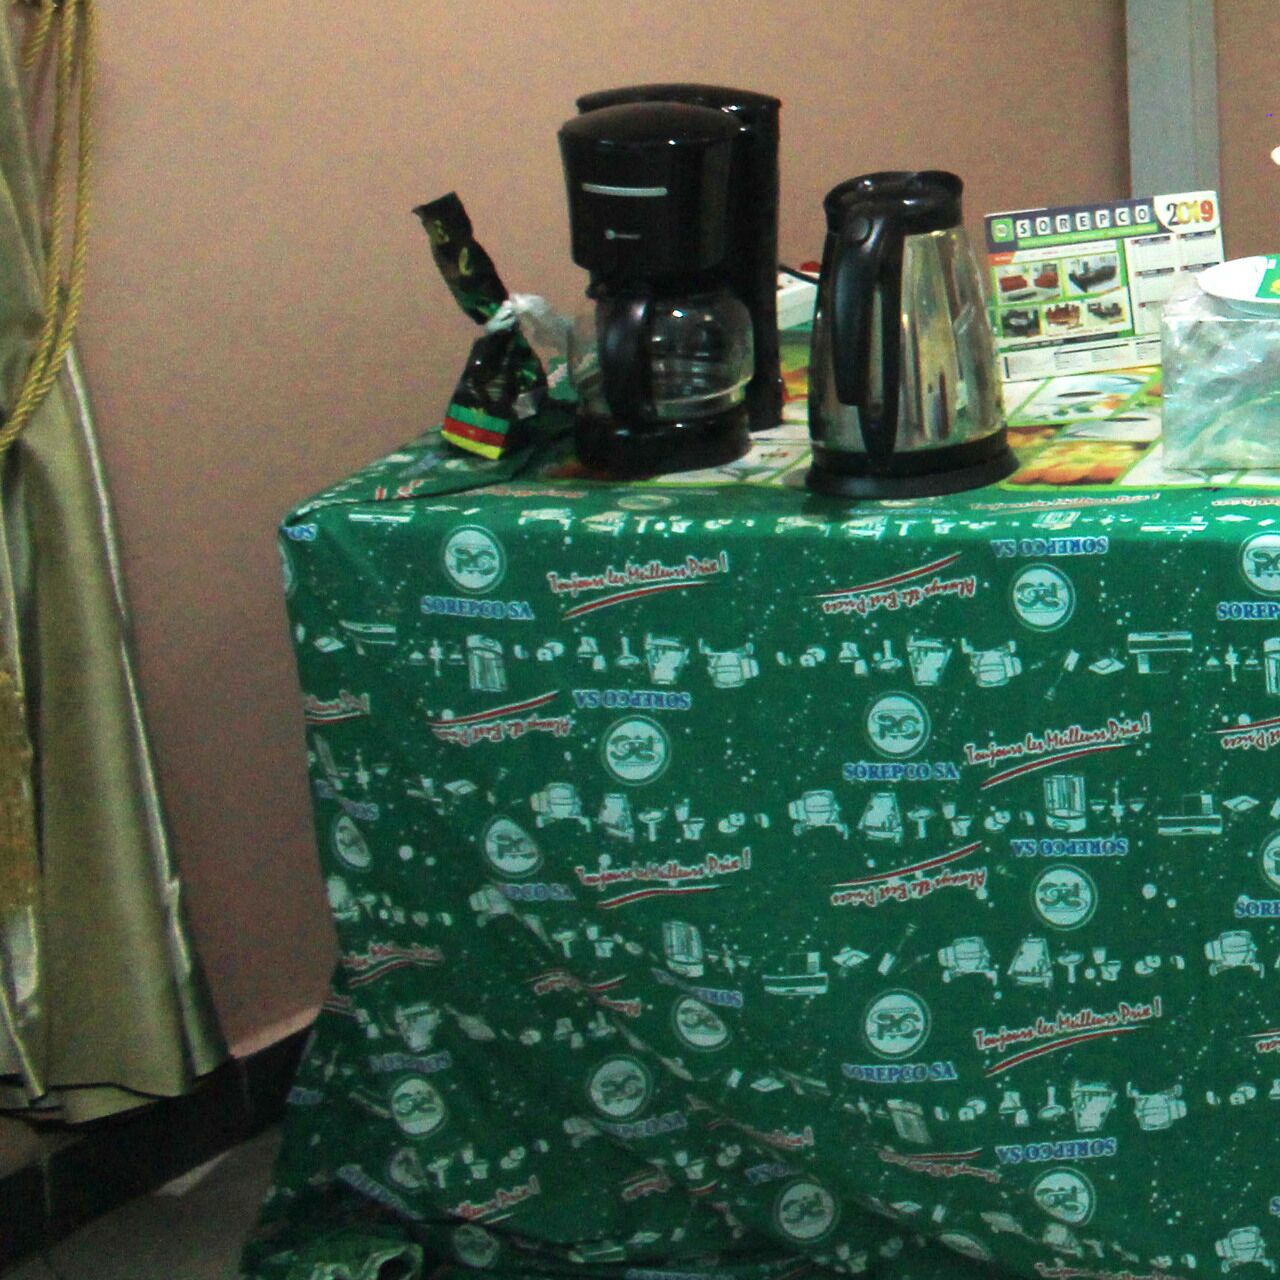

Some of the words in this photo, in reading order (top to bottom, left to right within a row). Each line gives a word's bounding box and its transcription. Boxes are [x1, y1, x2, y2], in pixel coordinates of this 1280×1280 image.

[1018, 206, 1149, 236] SOREPCO
[1166, 199, 1215, 226] 2019
[924, 577, 976, 596] Always
[869, 590, 900, 611] Best
[902, 587, 923, 607] the
[965, 743, 1023, 768] Toujours
[1024, 734, 1044, 754] les
[1044, 726, 1107, 749] Meilleurs
[1107, 718, 1142, 739] Prix
[843, 763, 930, 781] SOREPCO
[932, 763, 960, 781] SA
[1010, 840, 1038, 858] SA
[1039, 838, 1128, 857] SOREPCO
[1120, 1001, 1153, 1024] Prix
[996, 1145, 1022, 1164] SA
[1024, 1137, 1117, 1161] SOREPCO
